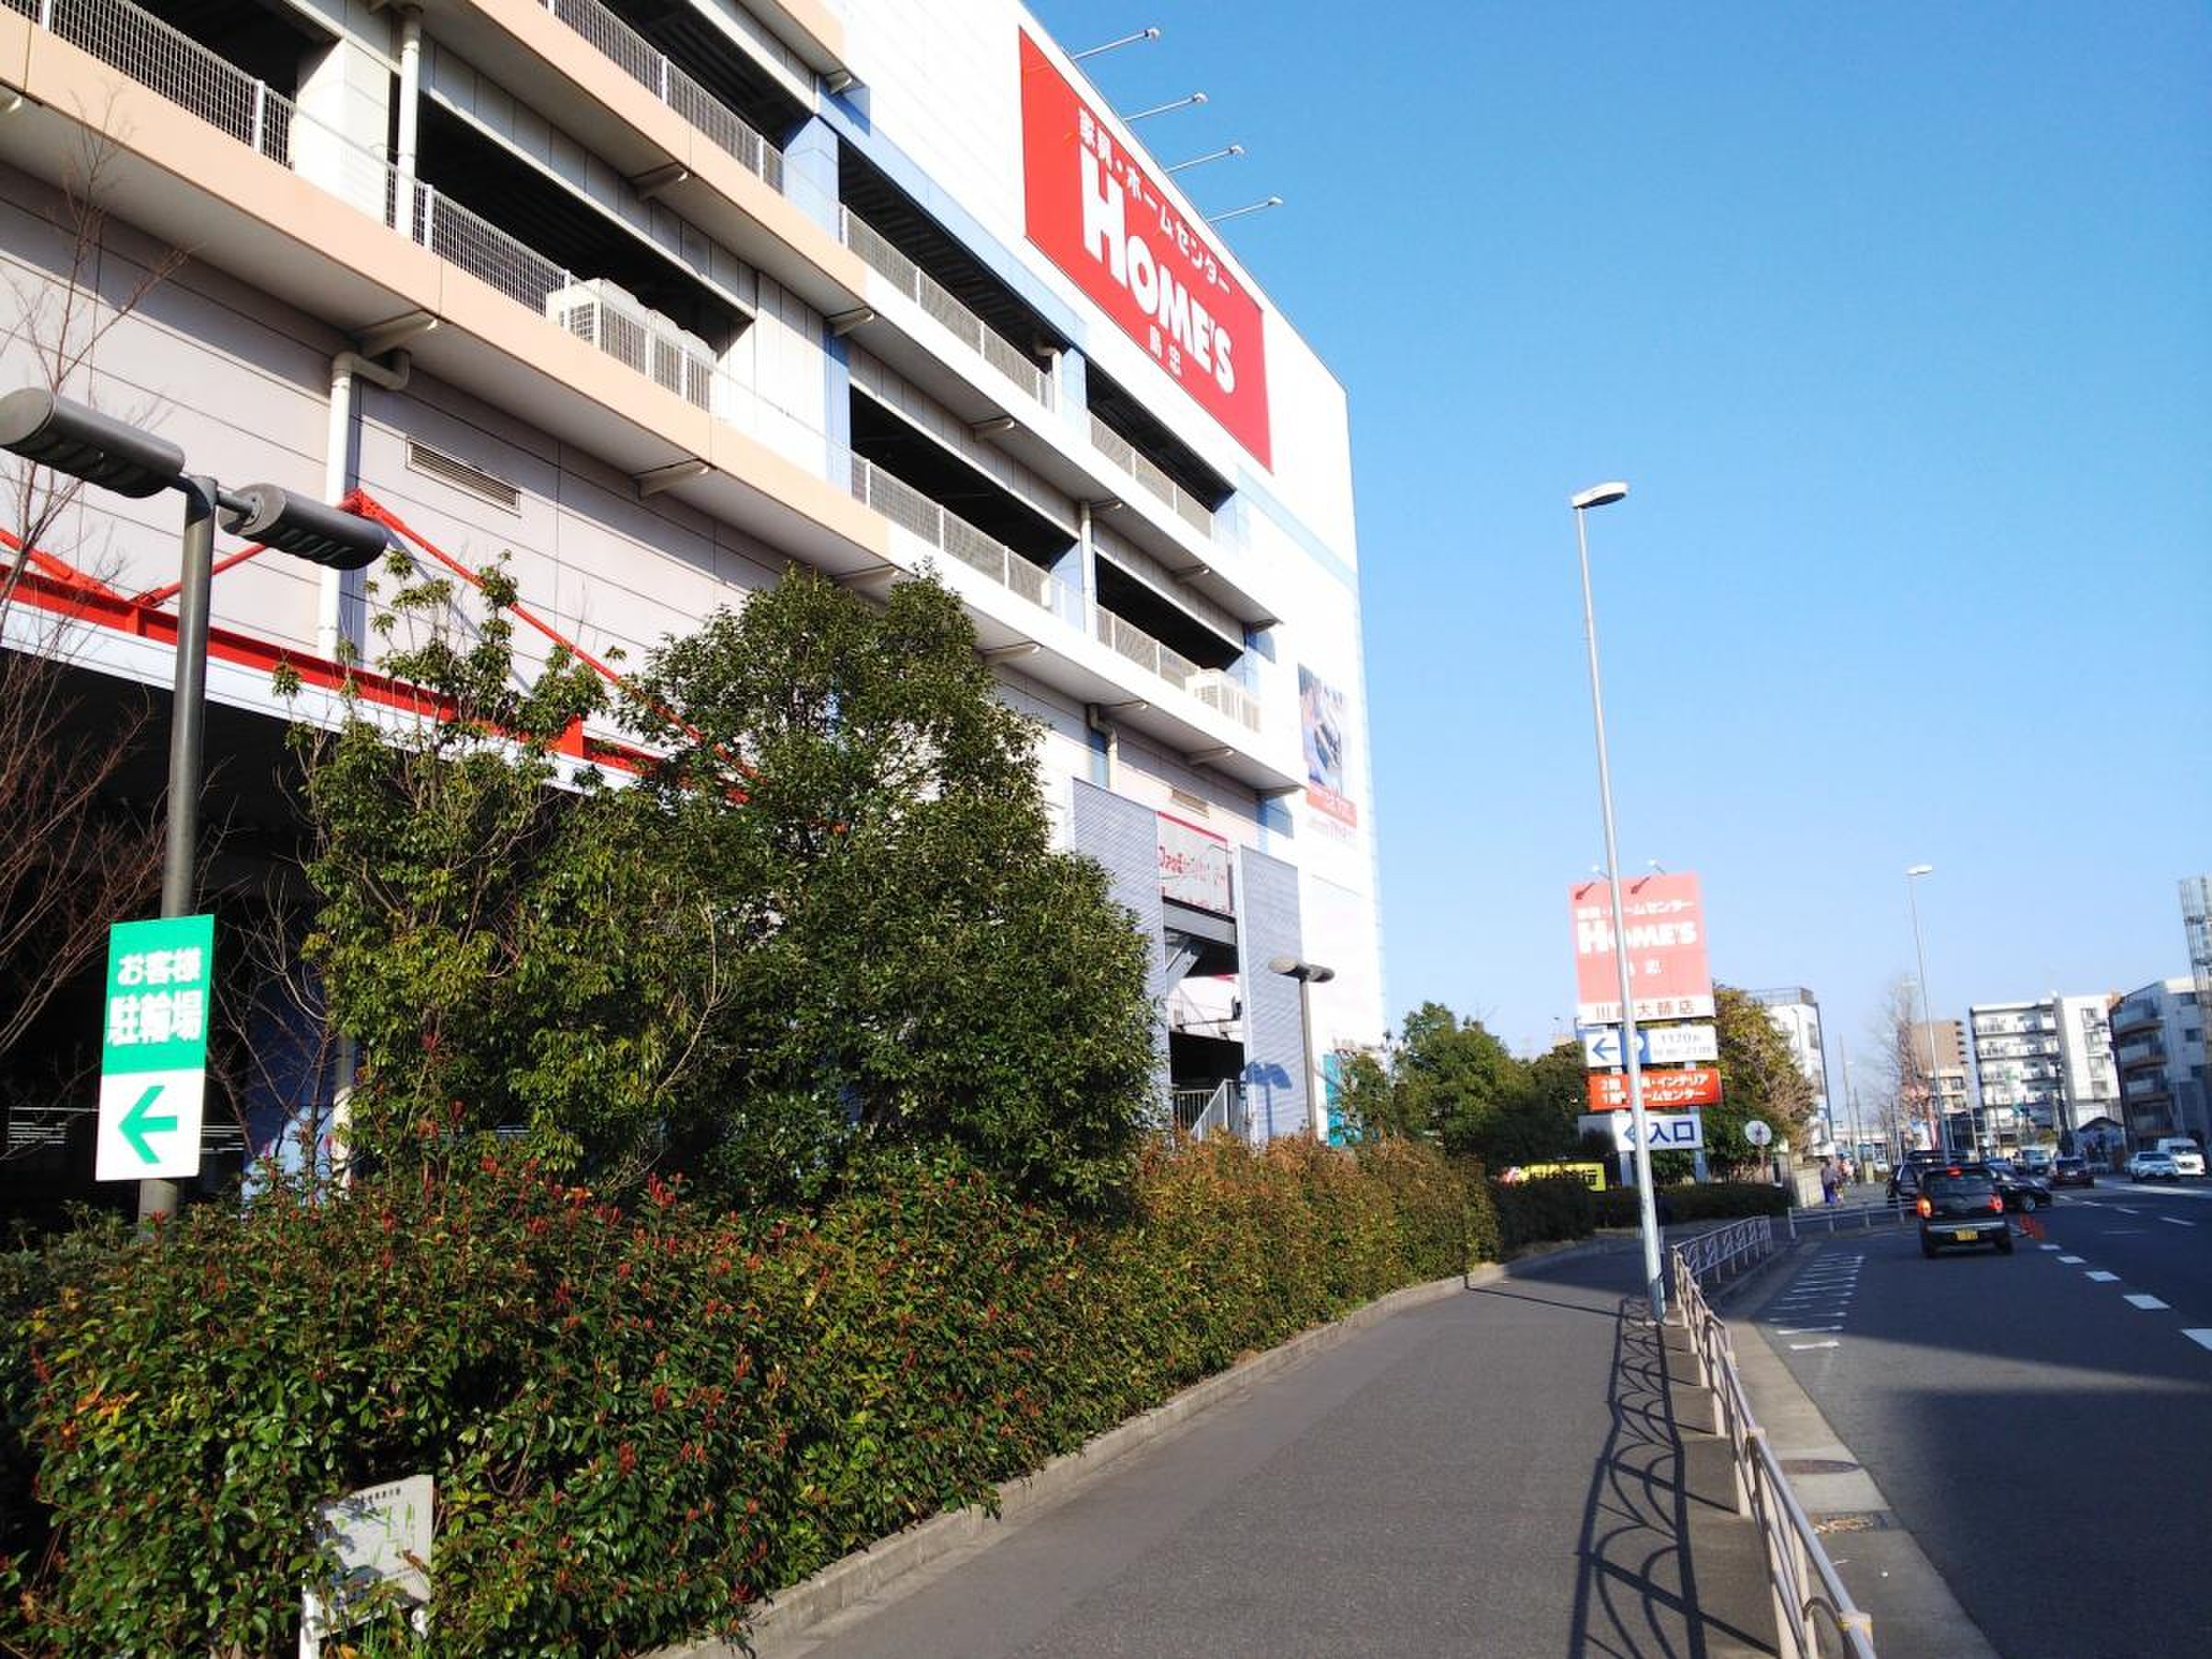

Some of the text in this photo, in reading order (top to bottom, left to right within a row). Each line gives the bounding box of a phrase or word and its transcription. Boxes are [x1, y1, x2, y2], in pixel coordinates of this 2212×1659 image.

[1079, 143, 1235, 394] HOME'S
[117, 947, 202, 986] お客様
[106, 990, 204, 1047] 駐輪場
[1648, 1121, 1696, 1143] 入口
